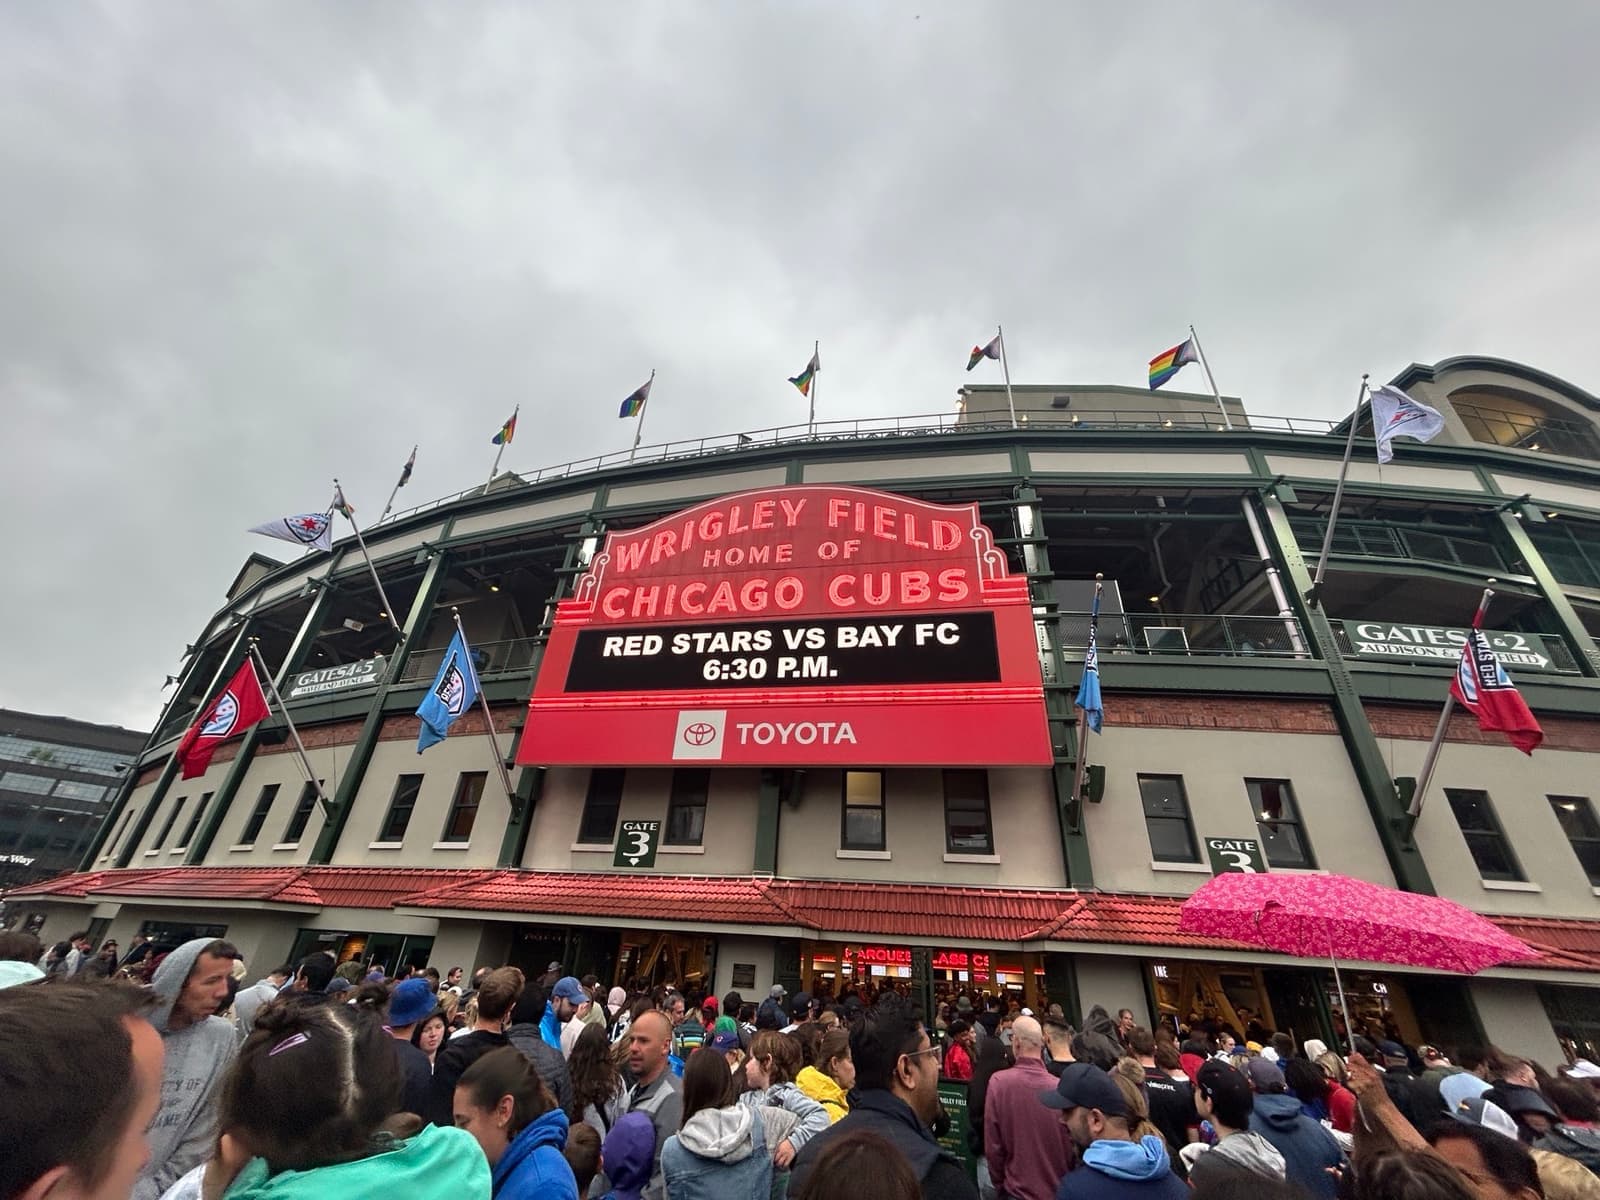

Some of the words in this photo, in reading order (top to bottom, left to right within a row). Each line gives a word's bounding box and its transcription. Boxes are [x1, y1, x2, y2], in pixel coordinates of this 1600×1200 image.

[616, 499, 807, 573] WRIGLEY
[828, 498, 962, 551] FIELD
[702, 544, 793, 568] HOME
[817, 539, 862, 560] OF
[602, 576, 804, 619] CHICAGO
[828, 568, 969, 607] CUBS
[603, 634, 663, 657] RED
[671, 629, 773, 655] STARS
[782, 627, 826, 650] VS
[837, 624, 903, 649] BAY
[915, 622, 961, 646] FC
[1356, 624, 1468, 647] GATES
[1503, 633, 1531, 652] 2
[1361, 643, 1437, 658] ADDISON
[298, 666, 348, 686] GATES
[703, 657, 767, 681] 6:30
[777, 655, 838, 679] P.M.
[736, 721, 857, 746] TOYOTA
[623, 822, 659, 831] GATE
[622, 831, 650, 857] 3
[1209, 840, 1257, 851] GATE
[10, 854, 36, 866] Way
